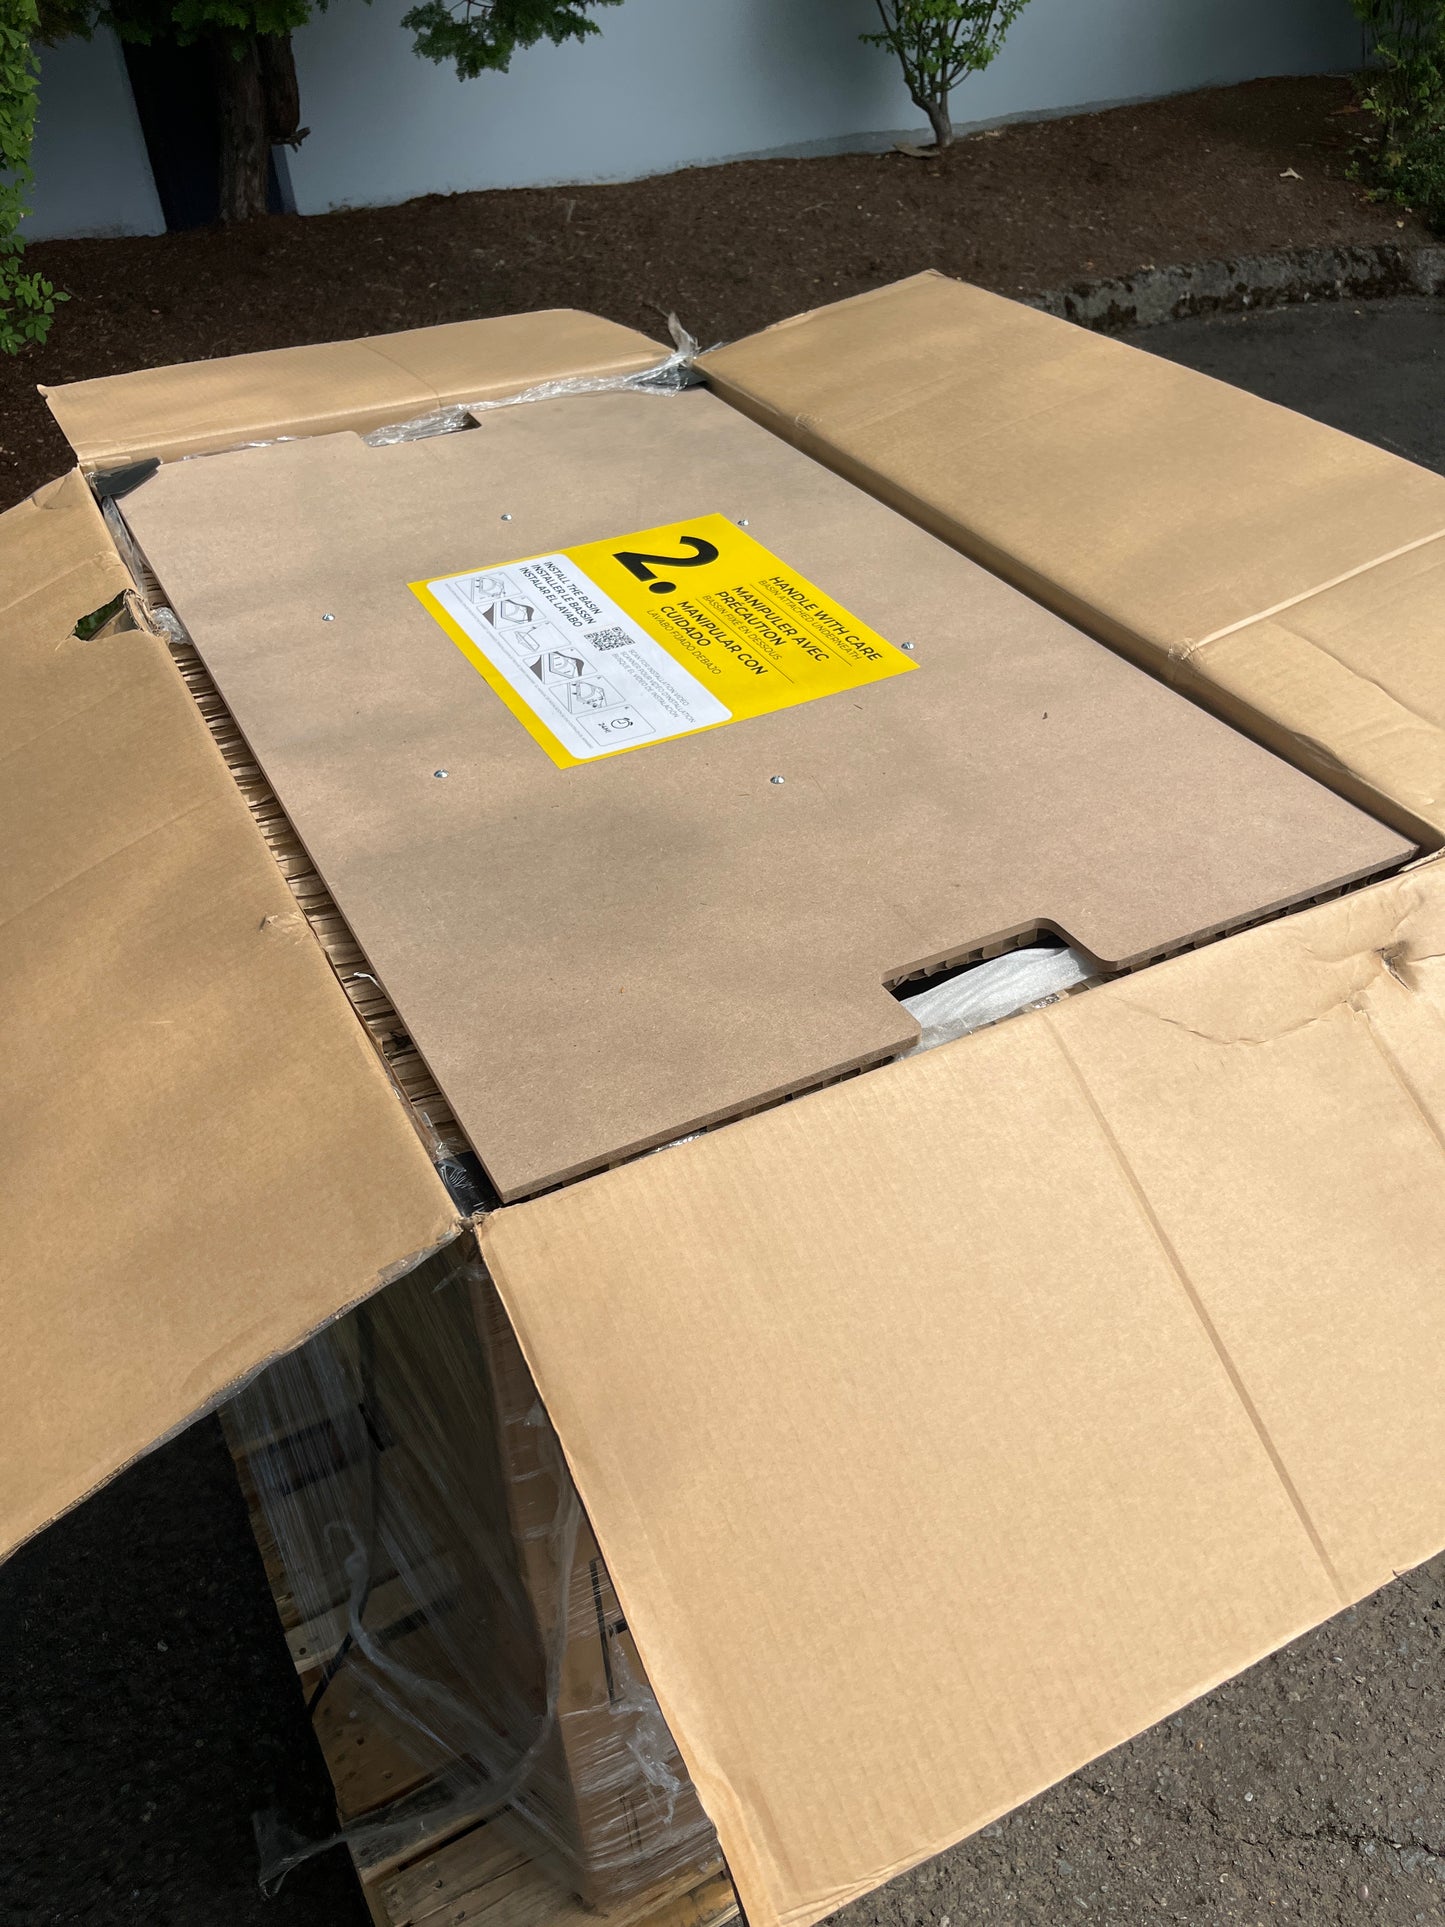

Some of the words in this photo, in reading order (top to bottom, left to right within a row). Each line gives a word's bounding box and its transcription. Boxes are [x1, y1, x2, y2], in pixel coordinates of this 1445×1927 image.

[530, 564, 566, 594] INSTALLER
[560, 593, 574, 602] LE
[568, 601, 596, 624] BASSIN
[542, 561, 571, 584] INSTALL
[565, 583, 583, 596] THE
[577, 595, 603, 614] BASIN
[612, 536, 719, 594] 2.
[518, 567, 551, 594] INSTALAR
[544, 594, 559, 602] EL
[553, 602, 584, 627] LAVABO
[658, 605, 713, 647] CUIDADO
[701, 595, 729, 614] BASSIN
[737, 625, 753, 634] EN
[747, 633, 783, 660] DESSOUS
[714, 591, 787, 646] PRÉCAUTION
[731, 586, 799, 636] MANIPULER
[791, 635, 831, 661] AVEC
[757, 580, 782, 595] BASIN
[776, 595, 815, 622] ATTACHED
[809, 621, 863, 660] UNDERNEATH
[768, 576, 819, 610] HANDLE
[811, 610, 850, 635] WITH
[842, 634, 883, 661] CARE
[645, 609, 675, 631] LAVABO
[669, 630, 697, 651] FIJADO
[691, 650, 723, 674] DEBAJO
[676, 600, 743, 653] MANIPULAR
[735, 652, 768, 675] CON
